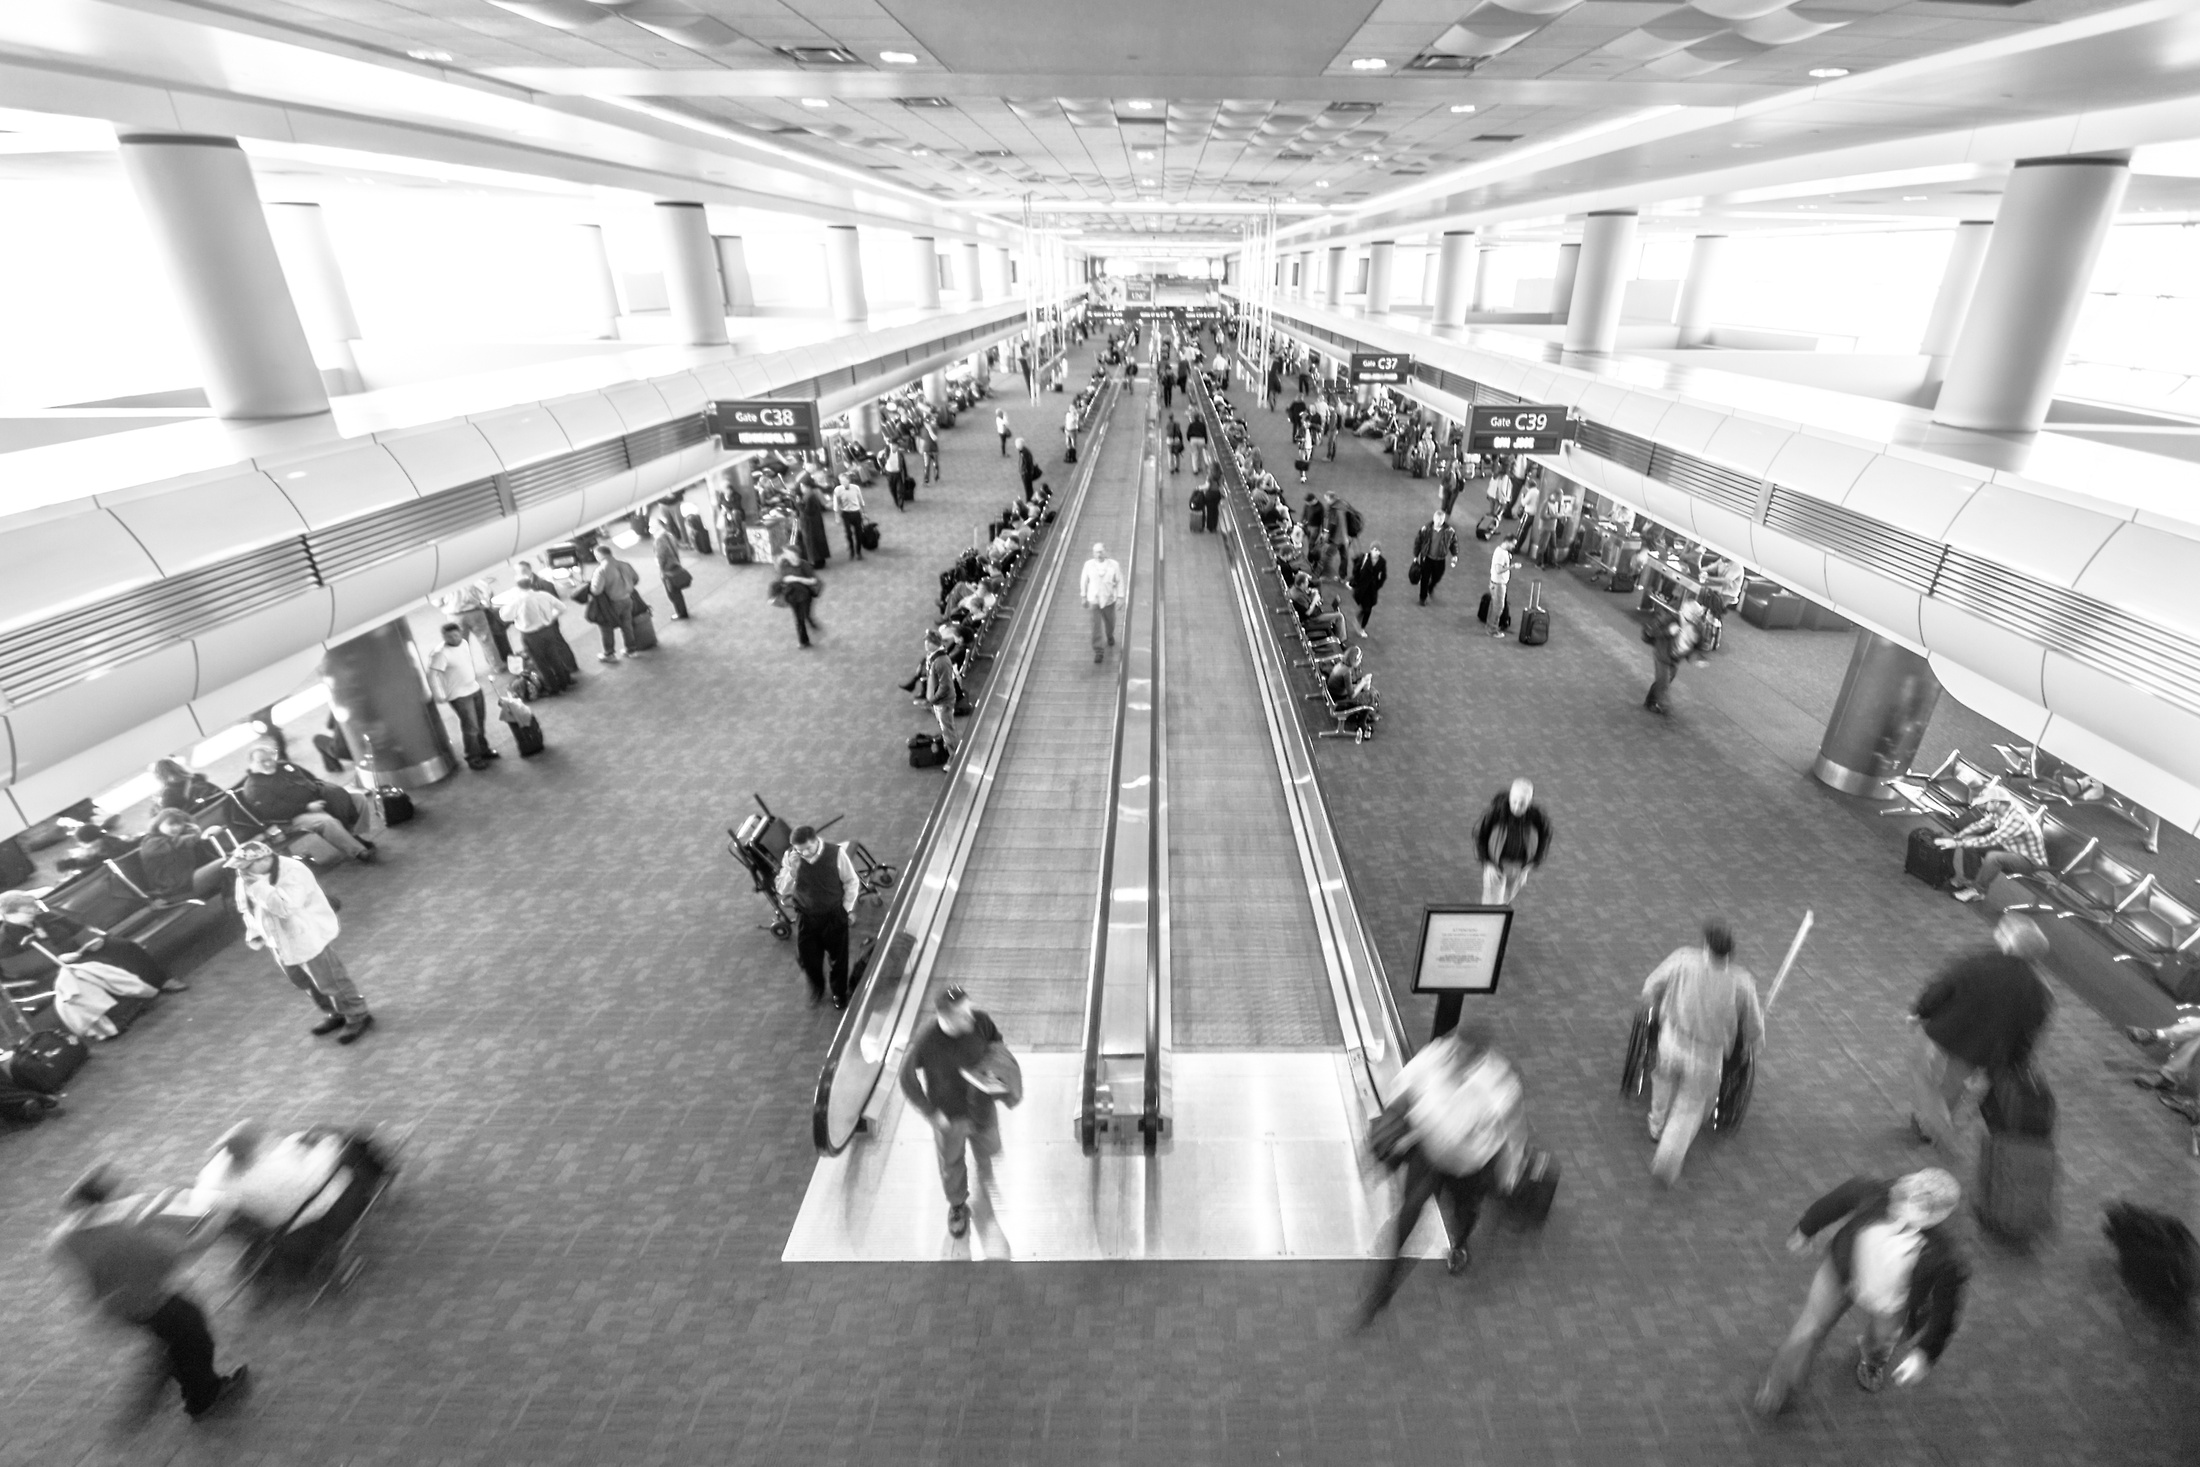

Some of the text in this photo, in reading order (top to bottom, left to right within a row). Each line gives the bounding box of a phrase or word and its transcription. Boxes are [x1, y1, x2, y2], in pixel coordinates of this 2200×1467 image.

[1362, 357, 1398, 370] Gate C37
[735, 408, 795, 426] Gate C38
[1490, 413, 1548, 431] Gate C39
